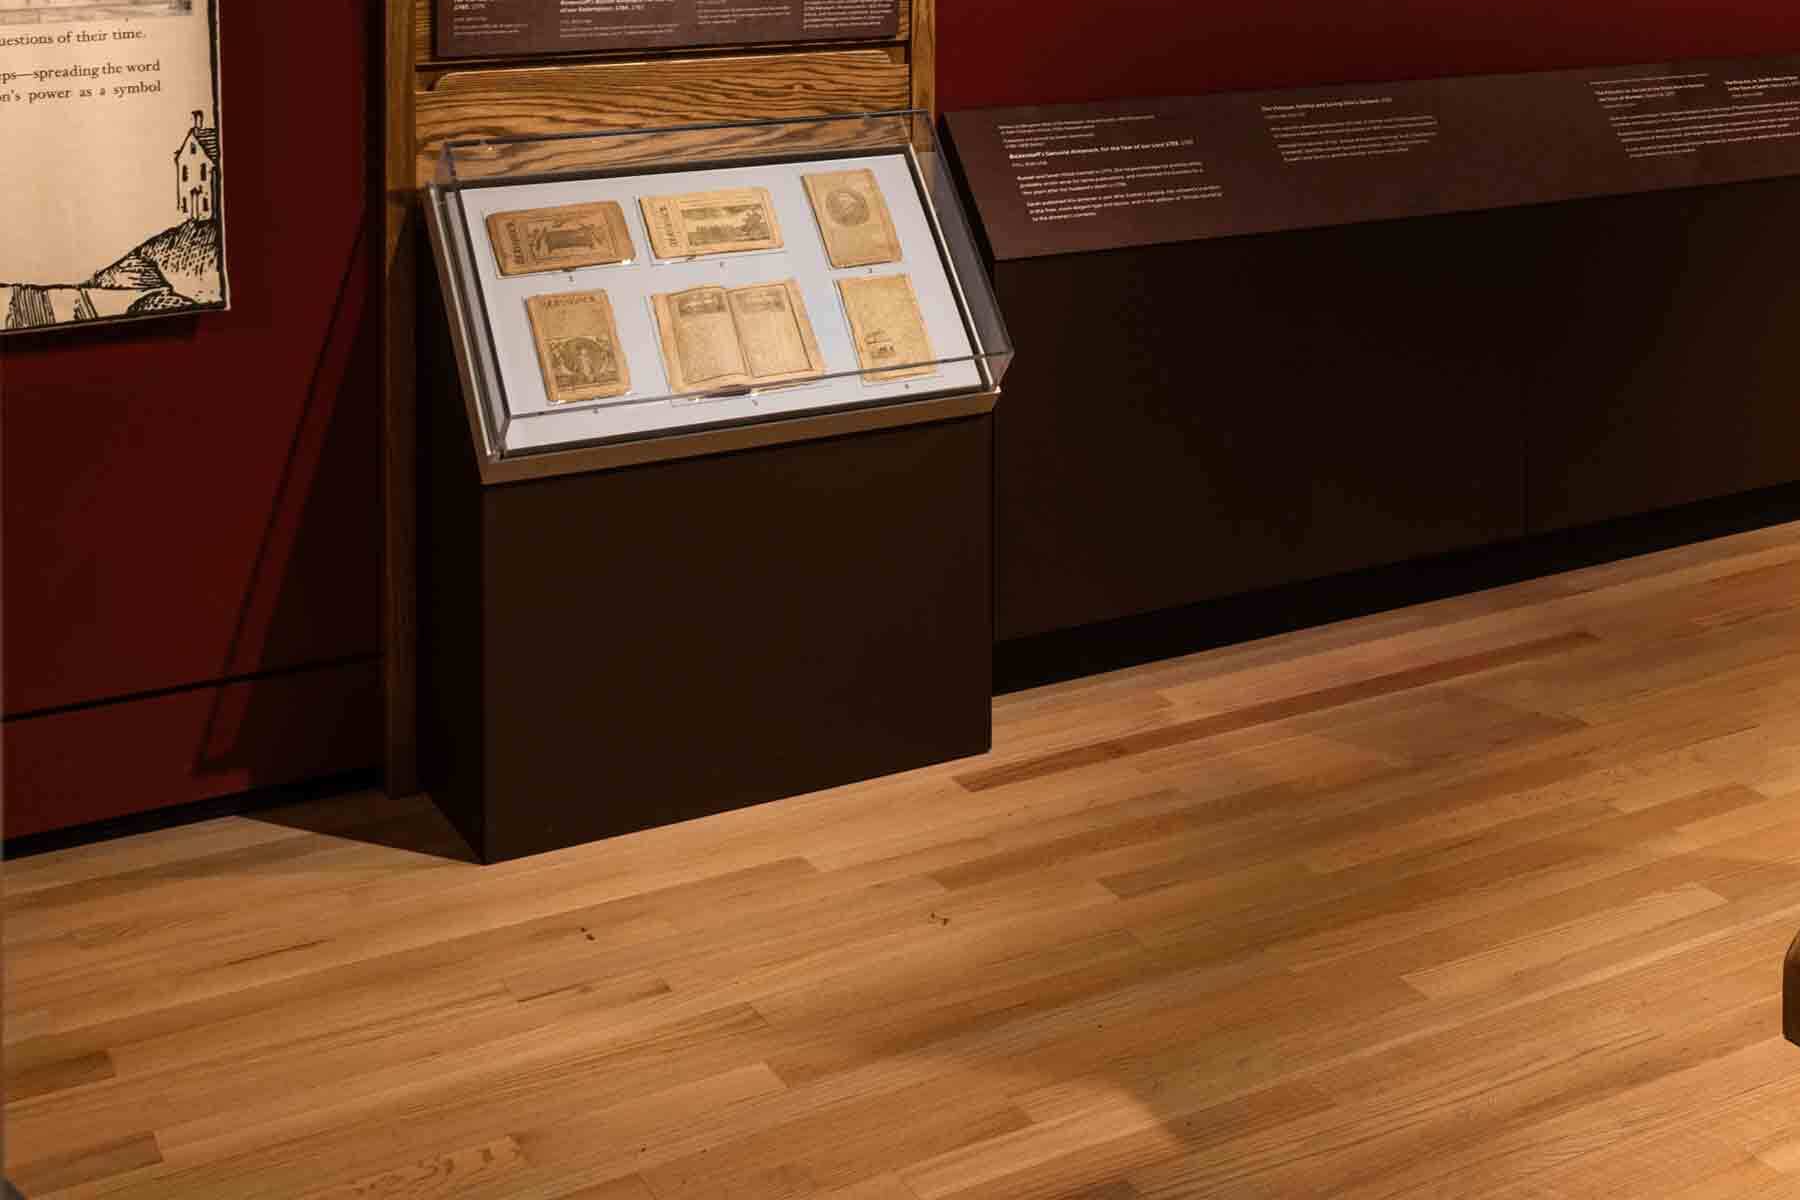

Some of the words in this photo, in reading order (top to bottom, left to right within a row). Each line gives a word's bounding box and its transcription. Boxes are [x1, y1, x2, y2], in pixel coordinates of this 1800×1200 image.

[57, 31, 73, 44] of
[76, 29, 108, 42] their
[111, 27, 147, 40] time.
[101, 61, 123, 75] the
[125, 58, 161, 73] word
[28, 87, 72, 104] power
[79, 87, 93, 97] as
[99, 86, 106, 96] a
[113, 80, 161, 98] symbol
